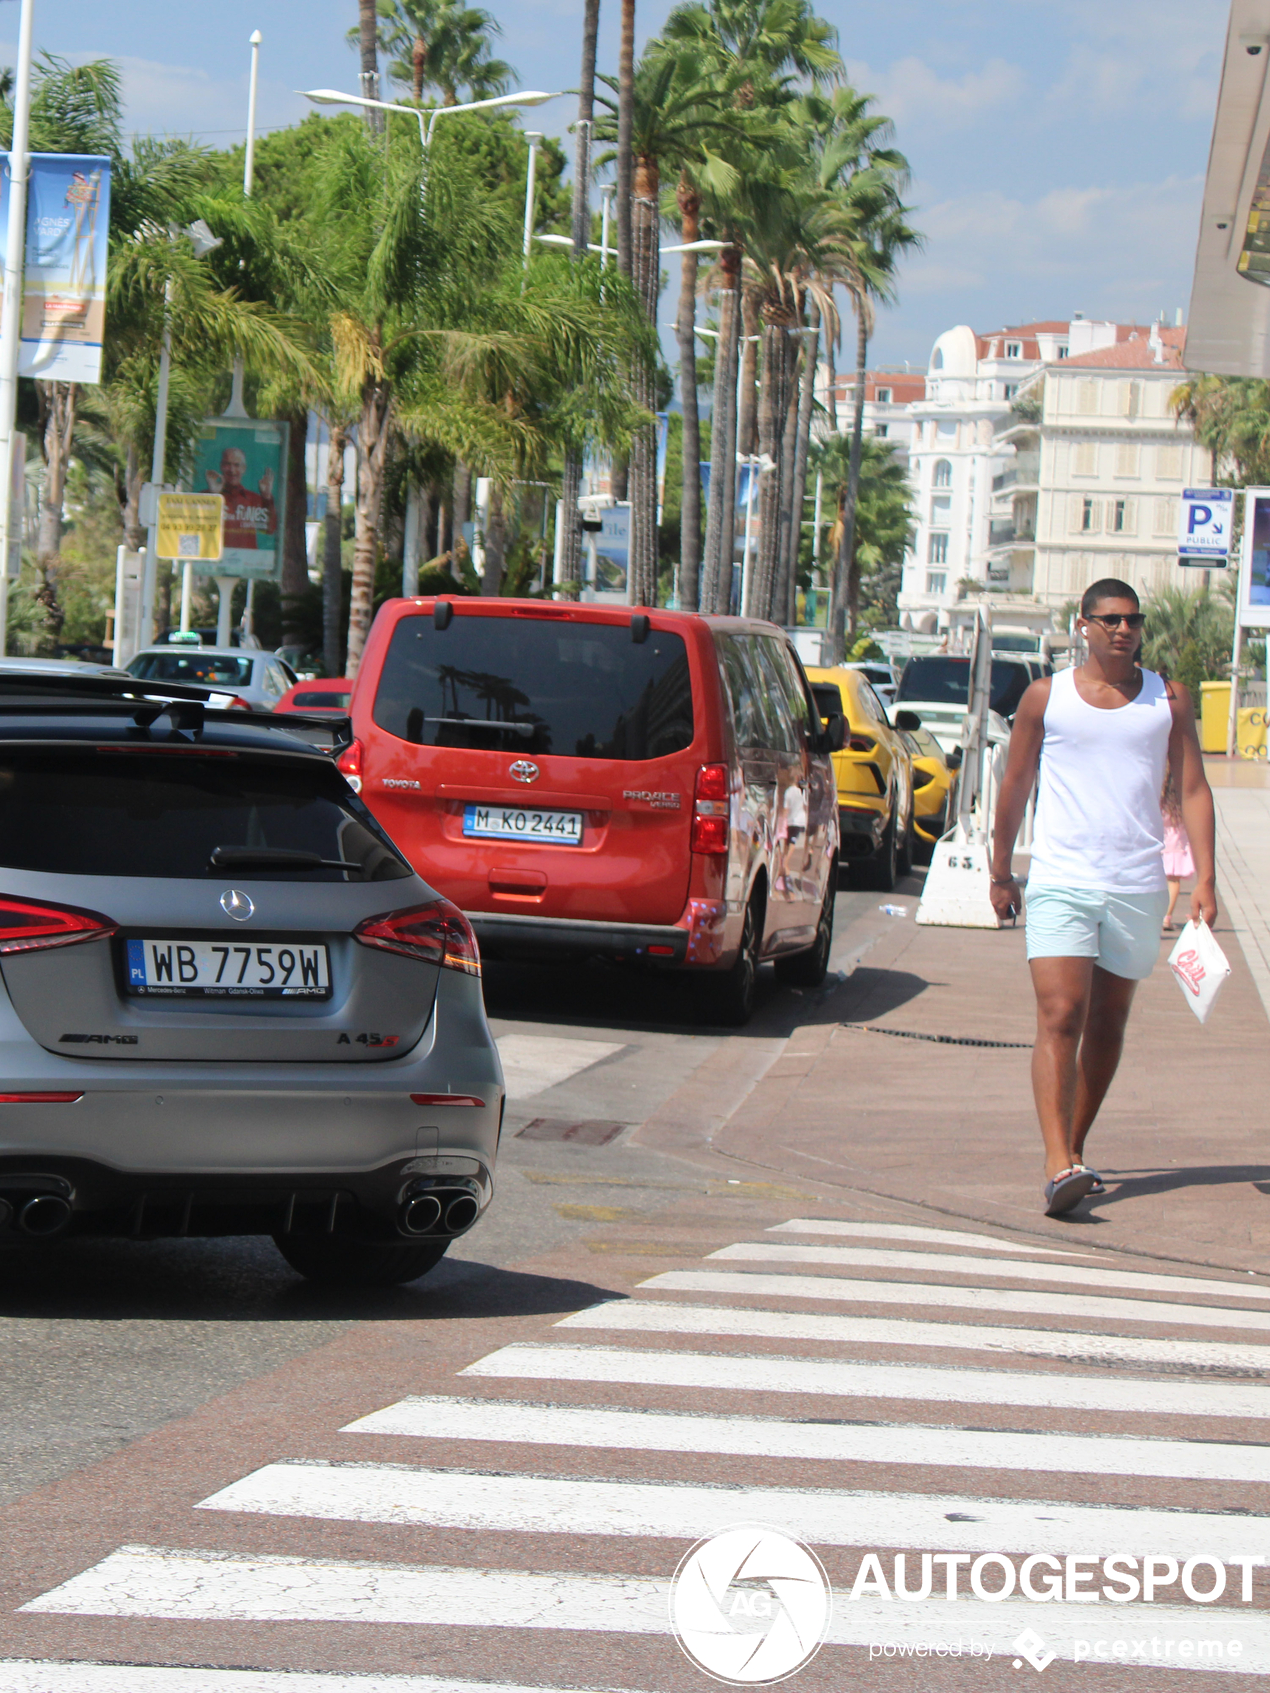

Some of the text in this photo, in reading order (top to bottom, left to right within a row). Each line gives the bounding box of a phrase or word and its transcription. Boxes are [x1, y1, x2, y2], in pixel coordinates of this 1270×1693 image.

[1187, 503, 1213, 534] P
[1186, 537, 1222, 545] PUBLIC
[382, 778, 422, 790] TOYOTA
[623, 790, 681, 801] PROACE
[650, 801, 681, 809] VERSO
[476, 810, 490, 828] M
[531, 814, 578, 835] 2441
[131, 944, 319, 986] PL WB 7759W
[1174, 949, 1206, 988] Chill
[147, 986, 187, 994] Mercedes-Benz
[84, 1034, 138, 1045] AMG
[336, 1032, 351, 1045] A
[355, 1032, 381, 1046] 45
